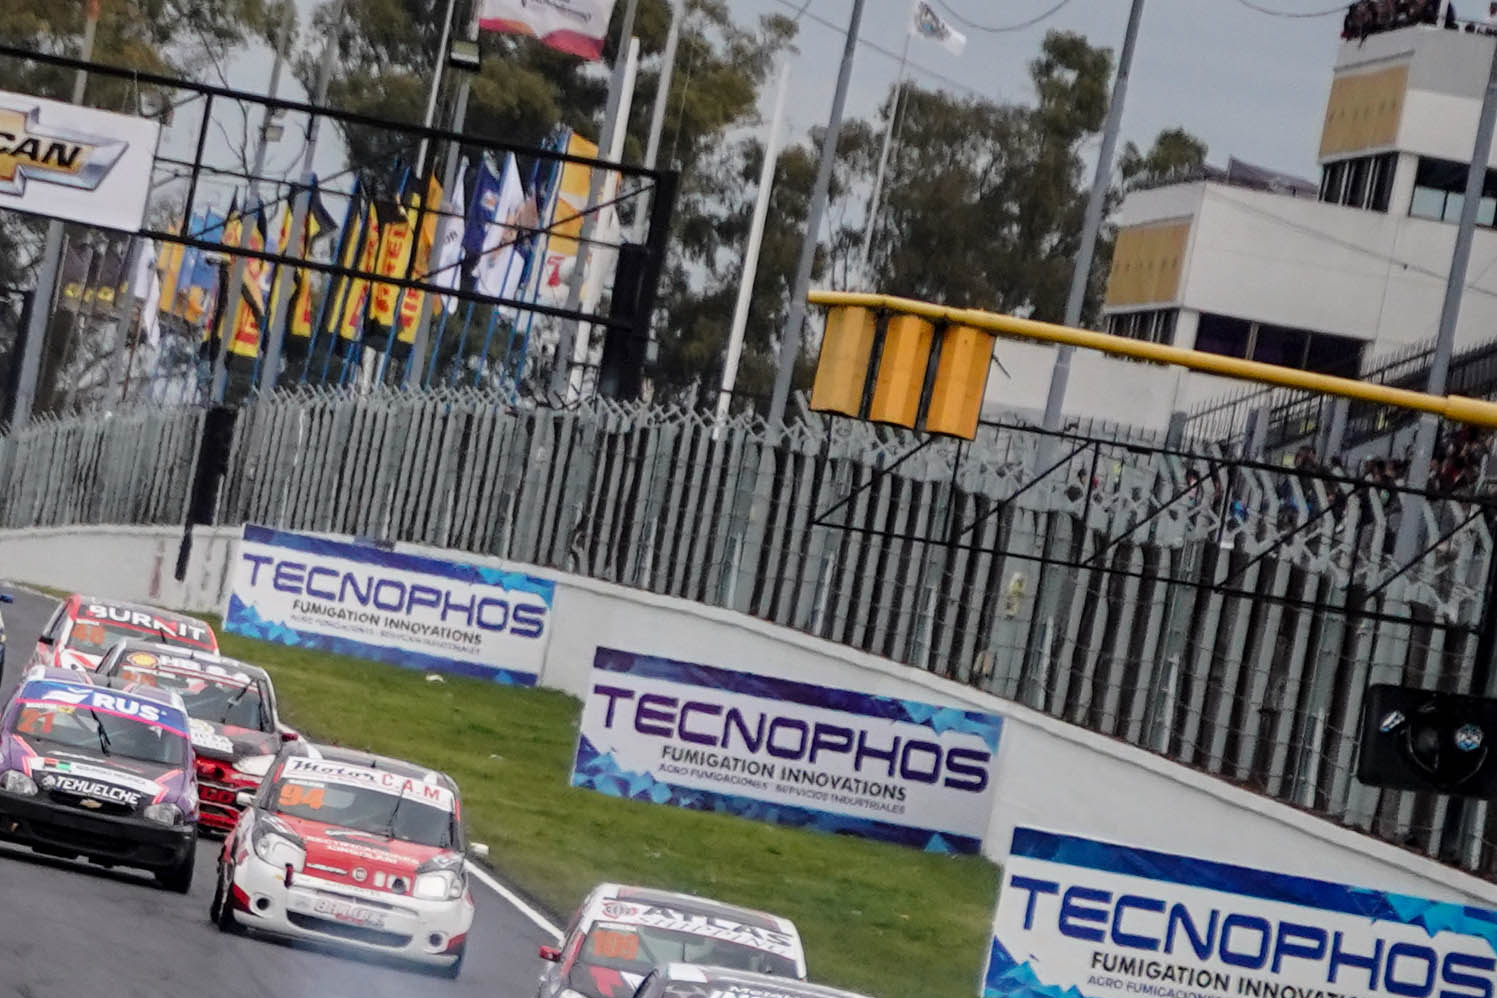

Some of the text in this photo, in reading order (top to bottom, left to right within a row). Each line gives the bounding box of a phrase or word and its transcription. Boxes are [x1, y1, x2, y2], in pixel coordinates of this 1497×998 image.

[242, 553, 549, 640] TECNOPHOS
[292, 599, 380, 626] FUMIGATION
[384, 617, 482, 646] INNOVATIONS
[17, 708, 55, 734] 21
[92, 692, 161, 721] RUS
[592, 684, 992, 793] TECNOPHOS
[55, 774, 142, 805] TEHUELCHE
[662, 745, 907, 801] FUMIGATION INNOVATIONS
[279, 783, 326, 810] 94
[1087, 975, 1124, 990] AGRO
[1091, 951, 1230, 992] FUMIGATION
